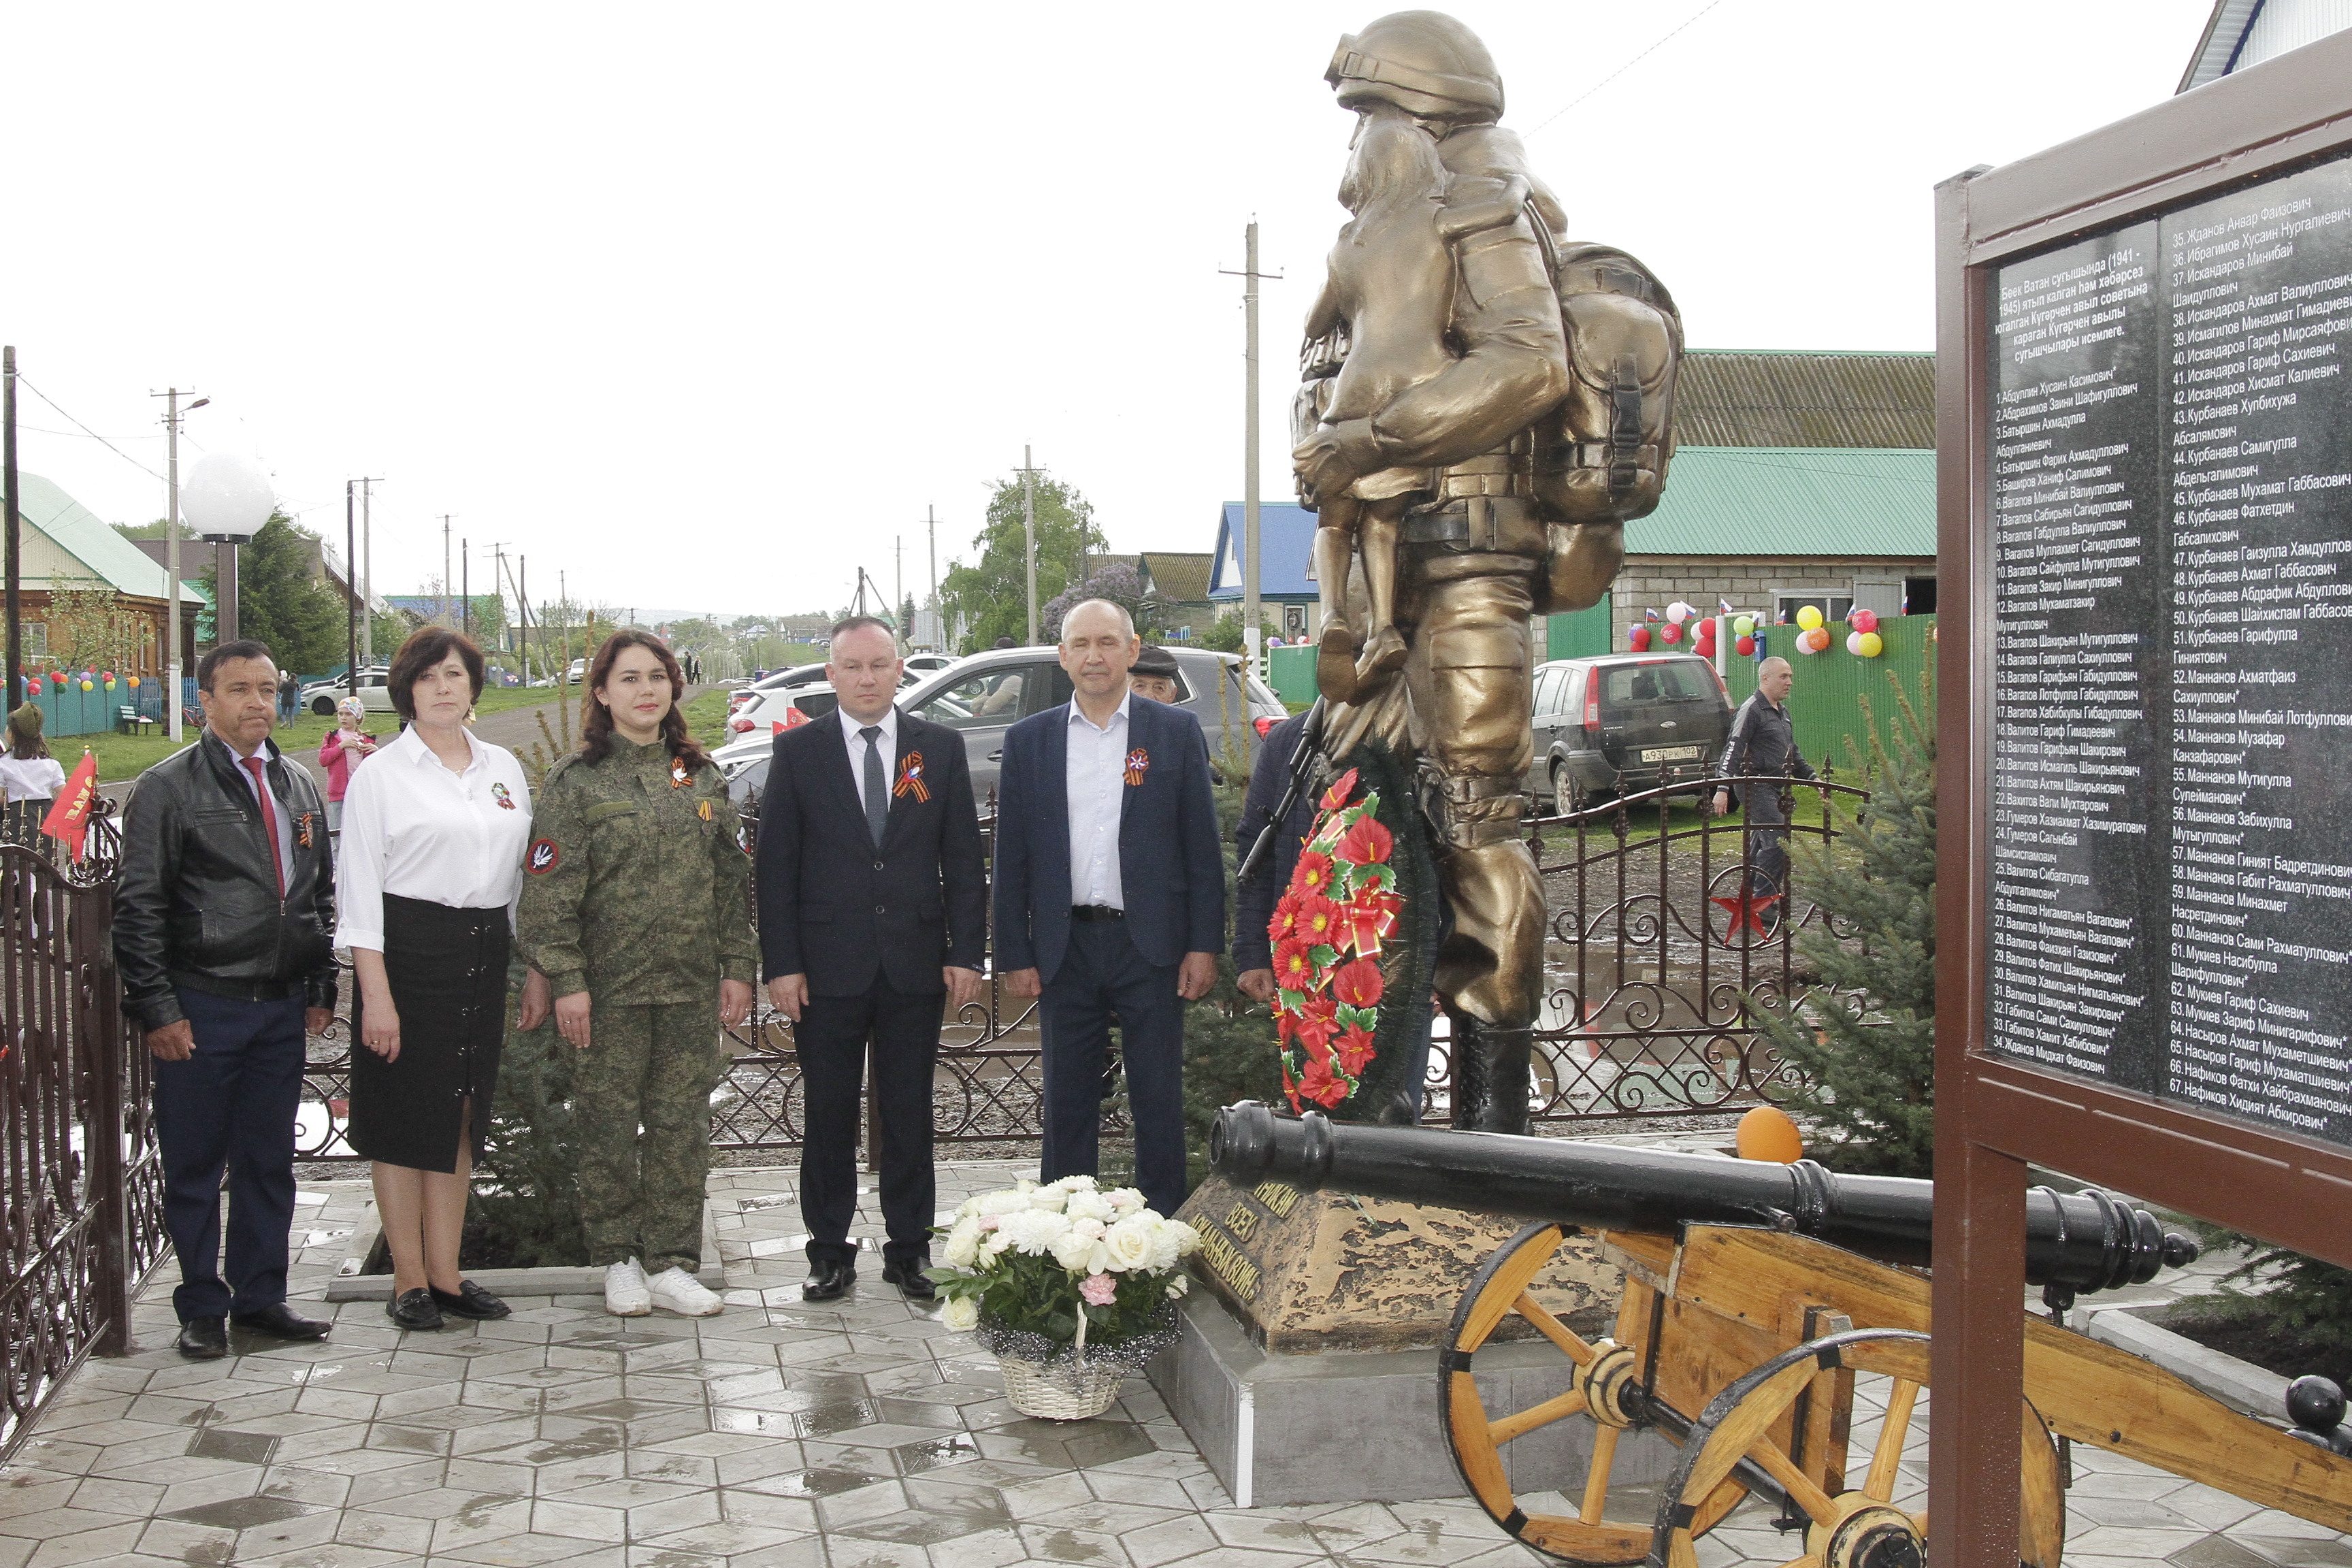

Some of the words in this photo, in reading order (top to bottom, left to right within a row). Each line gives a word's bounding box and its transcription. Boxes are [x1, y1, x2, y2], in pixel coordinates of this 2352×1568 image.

[2227, 213, 2258, 232] Анвар
[2260, 197, 2311, 221] Фаизович
[2242, 227, 2278, 250] Хусаин
[2281, 207, 2351, 239] Нургалиевич
[2247, 241, 2293, 267] Минибай
[2173, 281, 2238, 308] Шаидуллович
[2247, 291, 2279, 310] Ахмат
[2242, 309, 2294, 331] Минахмат
[2247, 330, 2281, 352] Гариф
[2247, 350, 2281, 372] Гариф
[2283, 342, 2335, 363] Сахиевич
[2247, 374, 2285, 392] Хисмат
[2288, 363, 2340, 384] Калиевич
[2173, 425, 2237, 446] Абсалямович
[2240, 436, 2297, 456] Самигулла
[2173, 464, 2258, 488] Абдельгалимович
[2241, 481, 2286, 501] Мухамат
[2288, 473, 2351, 493] Габбасович
[2240, 502, 2295, 519] Фатхетдин
[2174, 529, 2239, 547] Габсалихович
[2241, 545, 2287, 563] Гаизулла
[2240, 566, 2272, 581] Ахмат
[2274, 562, 2336, 579] Габбасович
[2240, 585, 2293, 604] Абдрафик
[2241, 606, 2300, 622] Шайхислам
[2241, 627, 2298, 646] Гарифулла
[2173, 650, 2227, 664] Гиниятович
[2238, 668, 2296, 687] Ахматфаиз
[2238, 709, 2284, 725] Минибай
[2238, 730, 2285, 749] Музафар
[1722, 740, 1735, 770] FRIDAY
[2238, 770, 2291, 790] Мутигулла
[2237, 811, 2292, 832] Забихулла
[2237, 851, 2272, 869] Гиният
[2237, 872, 2266, 889] Габит
[2237, 892, 2288, 913] Минахмет
[2236, 932, 2264, 951] Сами
[2223, 951, 2277, 974] Насибулла
[2187, 983, 2222, 1004] Мукиев
[2224, 991, 2256, 1014] Гариф
[2258, 998, 2309, 1022] Сахиевич
[2222, 1011, 2255, 1034] Зариф
[2229, 1032, 2260, 1052] Ахмат
[2229, 1051, 2261, 1076] Гариф
[2230, 1073, 2259, 1094] Фатхи
[2229, 1092, 2266, 1115] Хидият
[1225, 1202, 1258, 1240] ВСЕХ
